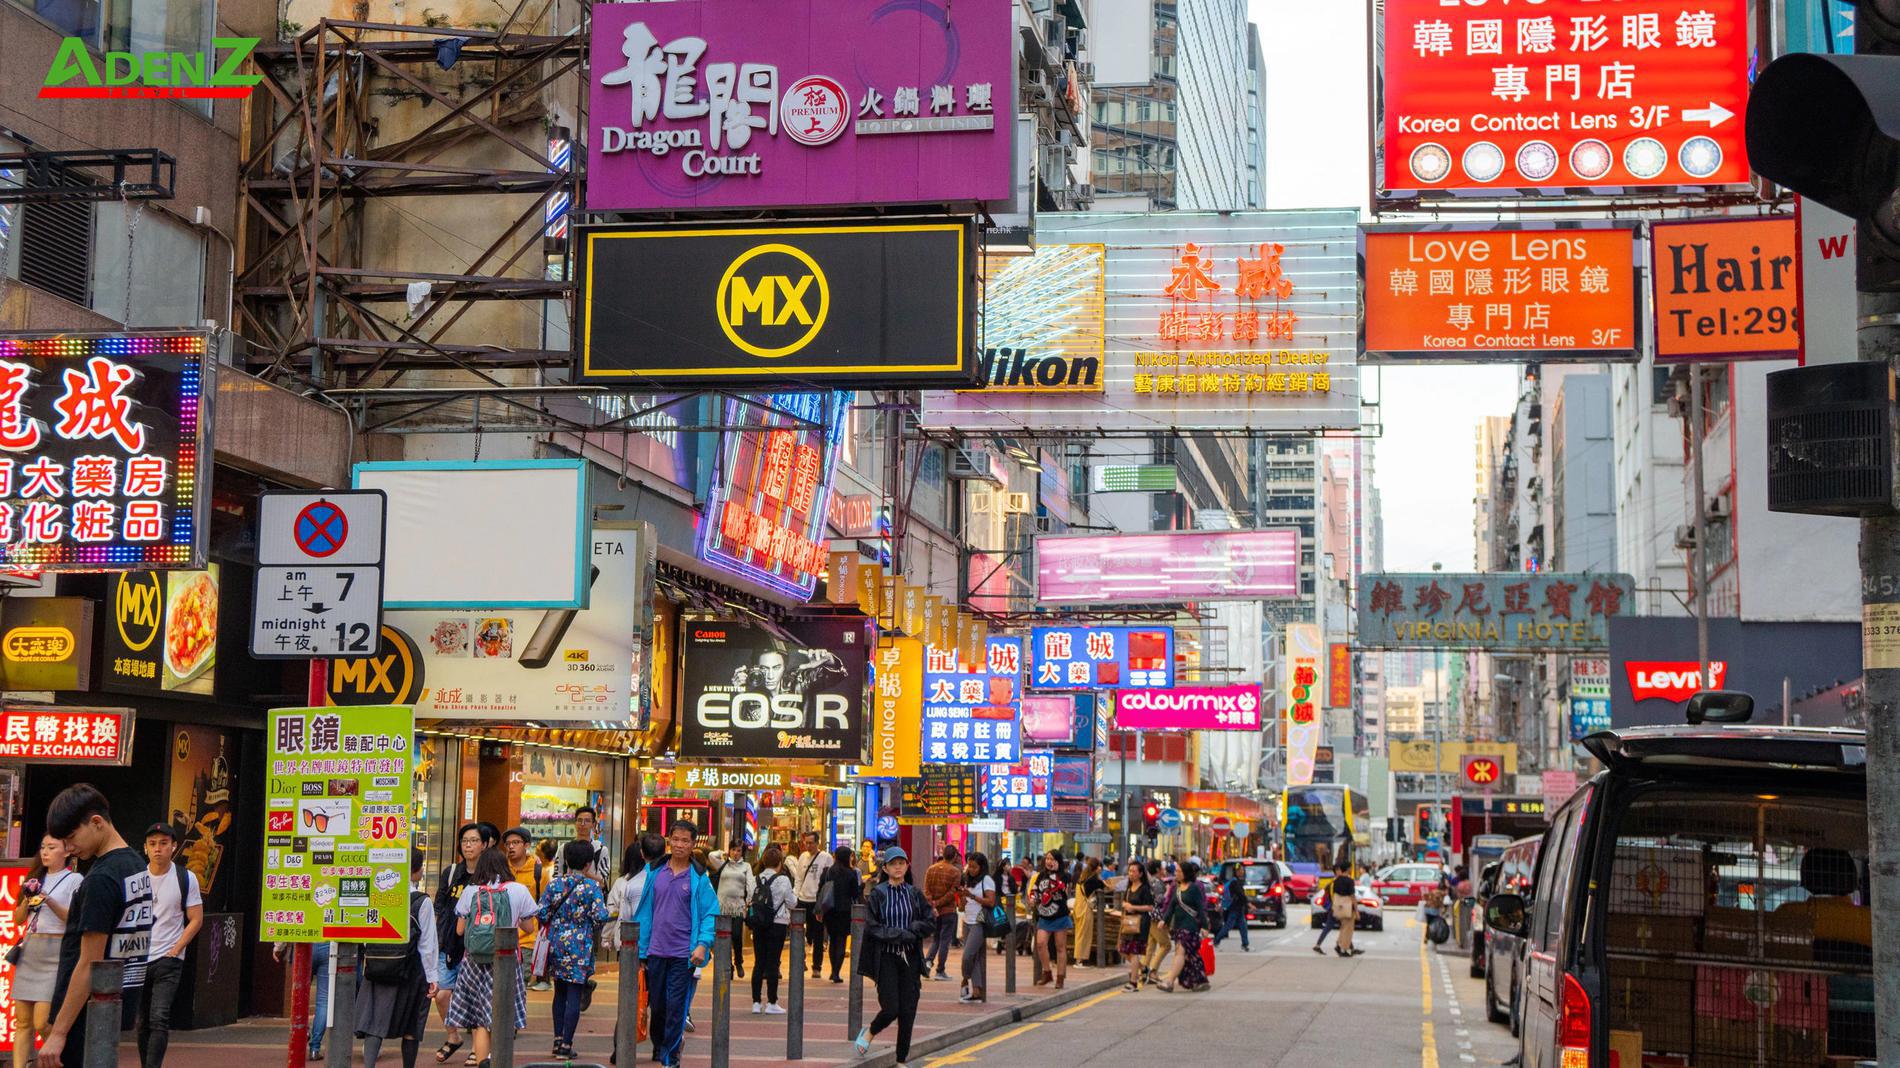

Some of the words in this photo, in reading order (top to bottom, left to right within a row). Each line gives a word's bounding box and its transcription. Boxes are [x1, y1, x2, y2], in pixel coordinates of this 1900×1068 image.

[1413, 10, 1717, 57] 韓國隱形眼鏡
[1491, 61, 1635, 102] 專門店
[791, 107, 839, 117] PREMIUM
[858, 82, 993, 117] 火鍋料理
[1398, 116, 1460, 135] Korea
[1470, 112, 1560, 132] Contact
[1570, 110, 1617, 130] Lens
[1629, 105, 1670, 129] 3/F
[601, 126, 702, 155] Dragon
[682, 150, 761, 177] Court
[1409, 235, 1490, 262] Love
[1511, 233, 1586, 261] Lens
[1164, 242, 1293, 301] 永成
[1389, 265, 1610, 296] 韓國隱形眼鏡
[1668, 243, 1792, 294] Hair
[730, 275, 815, 326] MX
[1159, 310, 1297, 342] 攝影器材
[1446, 302, 1551, 331] 專門店
[1423, 334, 1467, 348] Korea
[1474, 334, 1536, 347] Contact
[1542, 332, 1575, 347] Lens
[1591, 329, 1622, 345] 3/F
[1134, 351, 1179, 367] Nikon
[1186, 350, 1271, 366] Authorized
[1279, 350, 1329, 365] Dealer
[286, 570, 307, 581] am
[335, 572, 355, 601] 7
[121, 580, 156, 627] MX
[277, 585, 314, 602] 上午
[261, 618, 326, 631] midnight
[335, 622, 370, 652] 12
[695, 630, 726, 638] Canon
[1392, 622, 1499, 641] VIRGINIA
[274, 634, 311, 651] 午夜
[568, 652, 585, 660] 4K
[1044, 632, 1113, 660] 龍城
[114, 657, 156, 679] 本商場地庫
[580, 663, 596, 672] 360
[927, 642, 1019, 674] 龍城
[332, 654, 398, 693] MX
[697, 692, 803, 729] EOS
[815, 694, 849, 729] R
[926, 706, 948, 718] LUNG
[948, 706, 970, 718] SENG
[0, 715, 118, 744] 民幣找換
[276, 714, 340, 753] 眼鏡
[344, 735, 406, 752] 驗配中心
[881, 700, 896, 769] BONJOUR
[33, 744, 116, 757] EXCHANGE
[271, 779, 297, 794] Dior
[303, 783, 323, 792] BOSS
[721, 771, 782, 787] BONJOUR
[372, 815, 398, 840] 50
[286, 855, 302, 864] D&G
[340, 854, 368, 863] GUCCI
